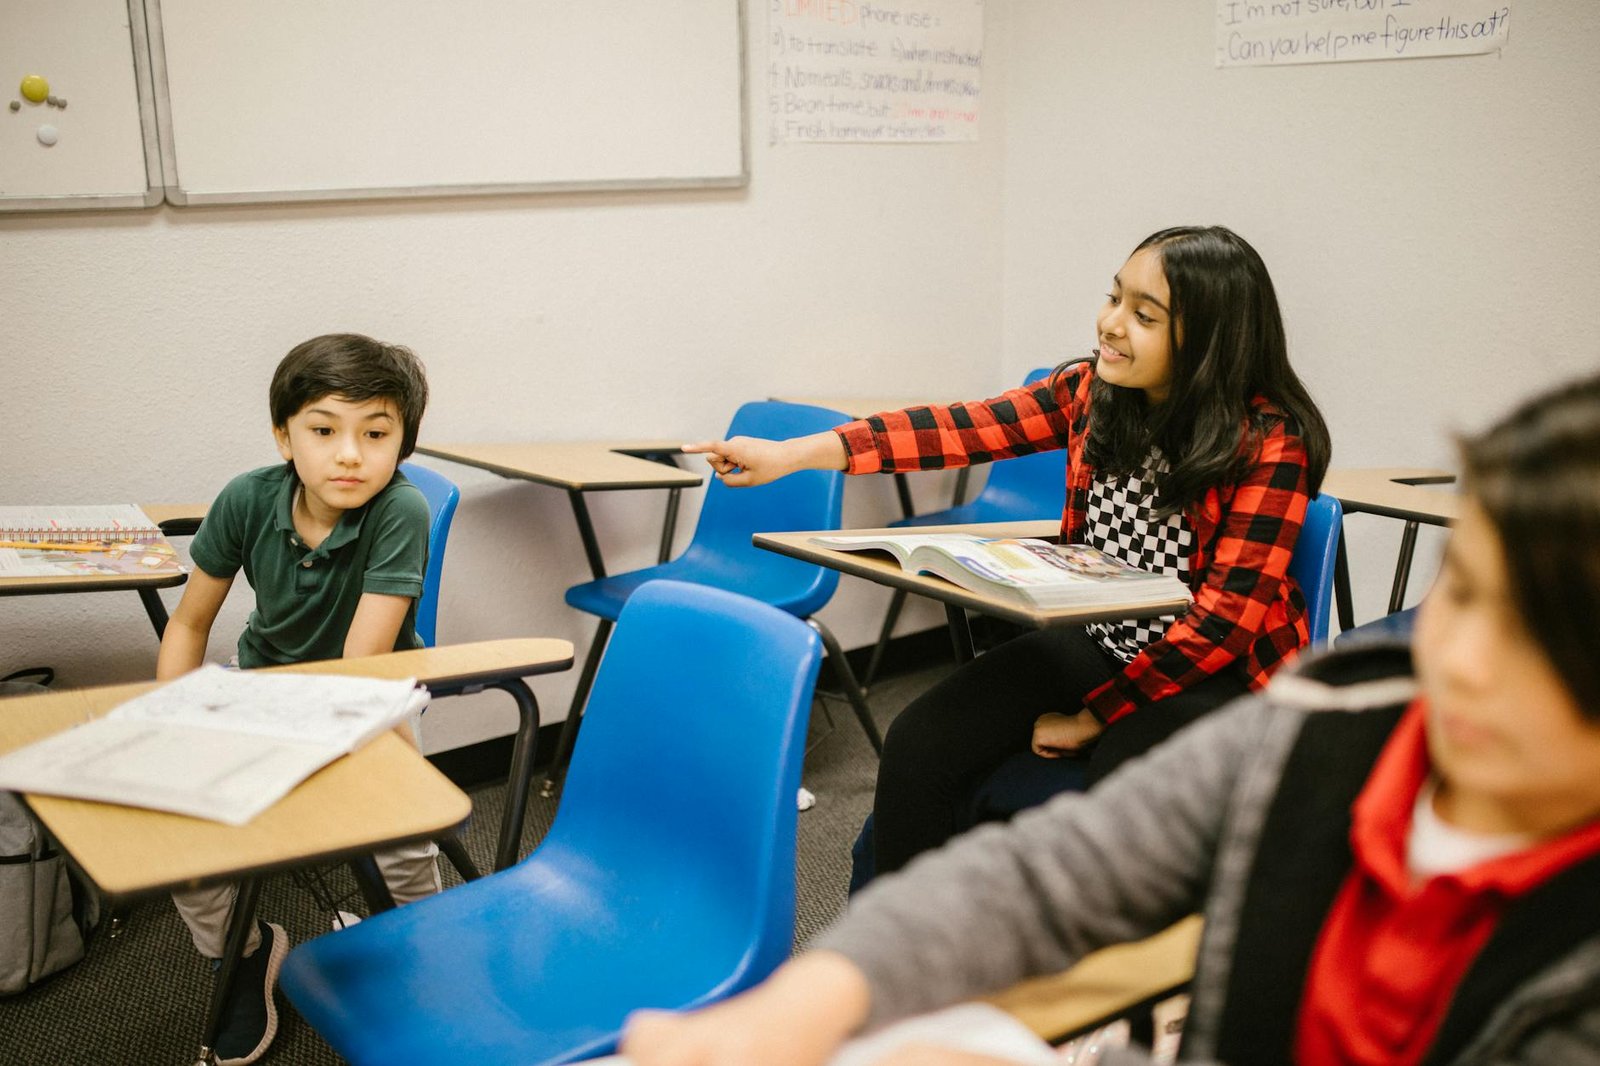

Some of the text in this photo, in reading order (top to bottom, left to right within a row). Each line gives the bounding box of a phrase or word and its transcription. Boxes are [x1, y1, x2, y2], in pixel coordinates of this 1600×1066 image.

[860, 4, 900, 29] phone
[1271, 0, 1300, 16] not
[789, 36, 805, 52] to
[1228, 30, 1265, 61] Can
[1269, 37, 1300, 62] you
[1304, 30, 1349, 59] help
[1352, 33, 1377, 45] me
[1380, 13, 1434, 53] figure
[1435, 16, 1468, 40] this
